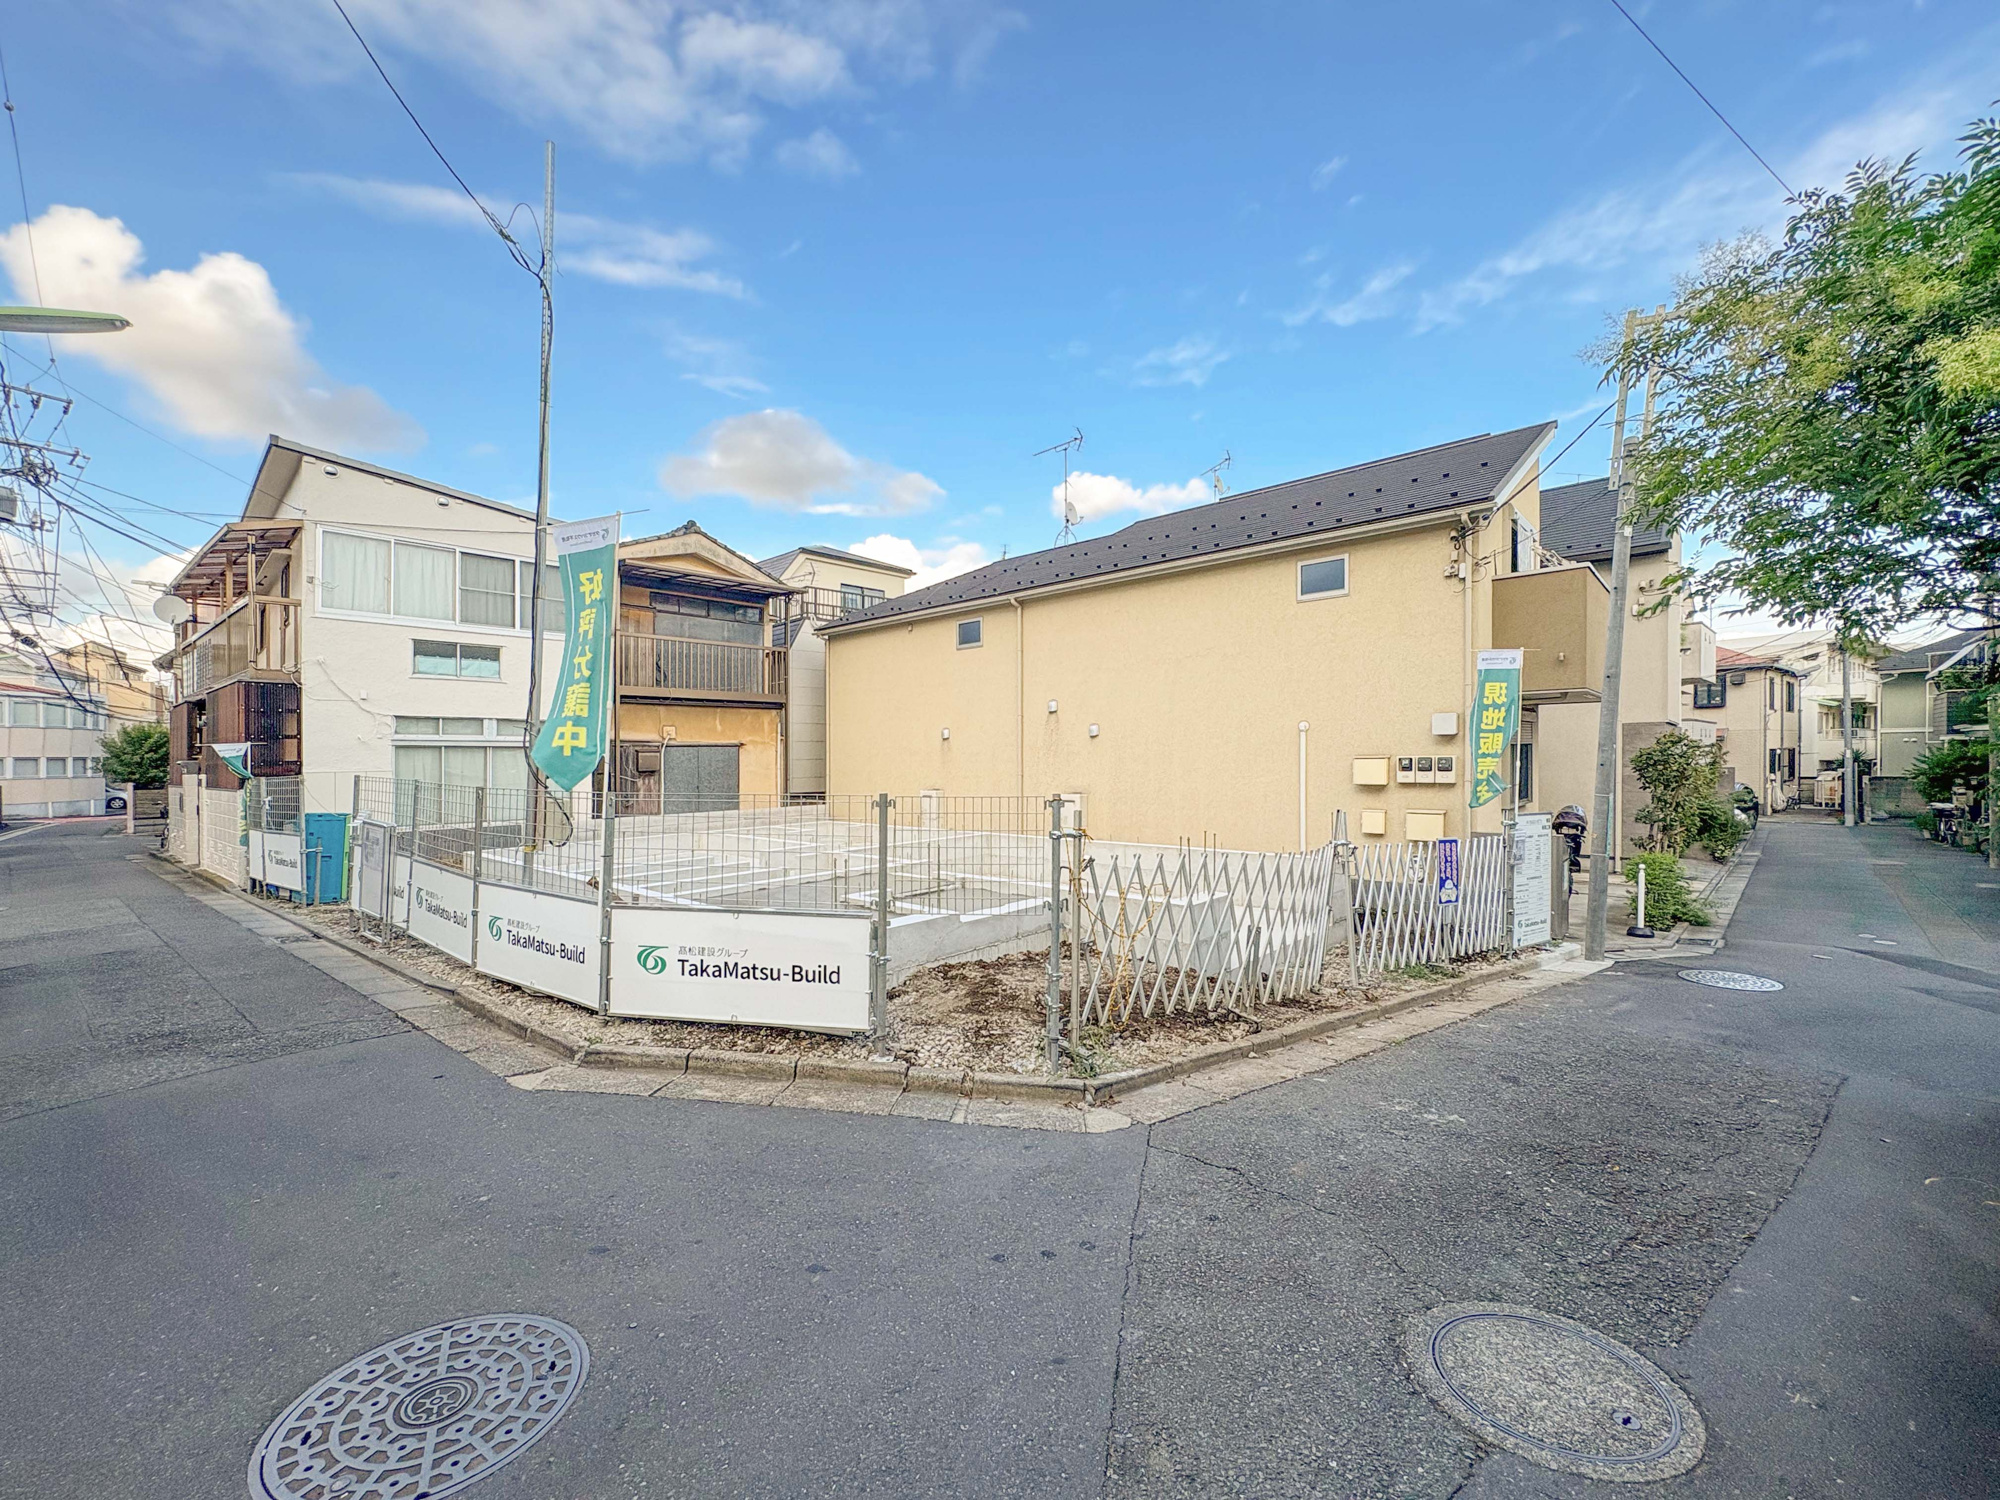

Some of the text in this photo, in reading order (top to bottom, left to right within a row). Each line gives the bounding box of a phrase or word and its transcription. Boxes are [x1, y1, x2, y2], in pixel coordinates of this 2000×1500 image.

[425, 898, 468, 928] TakaMatsu-Build
[506, 929, 586, 965] TakaMatsu-Build
[677, 958, 842, 985] TakaMatsu-Build
